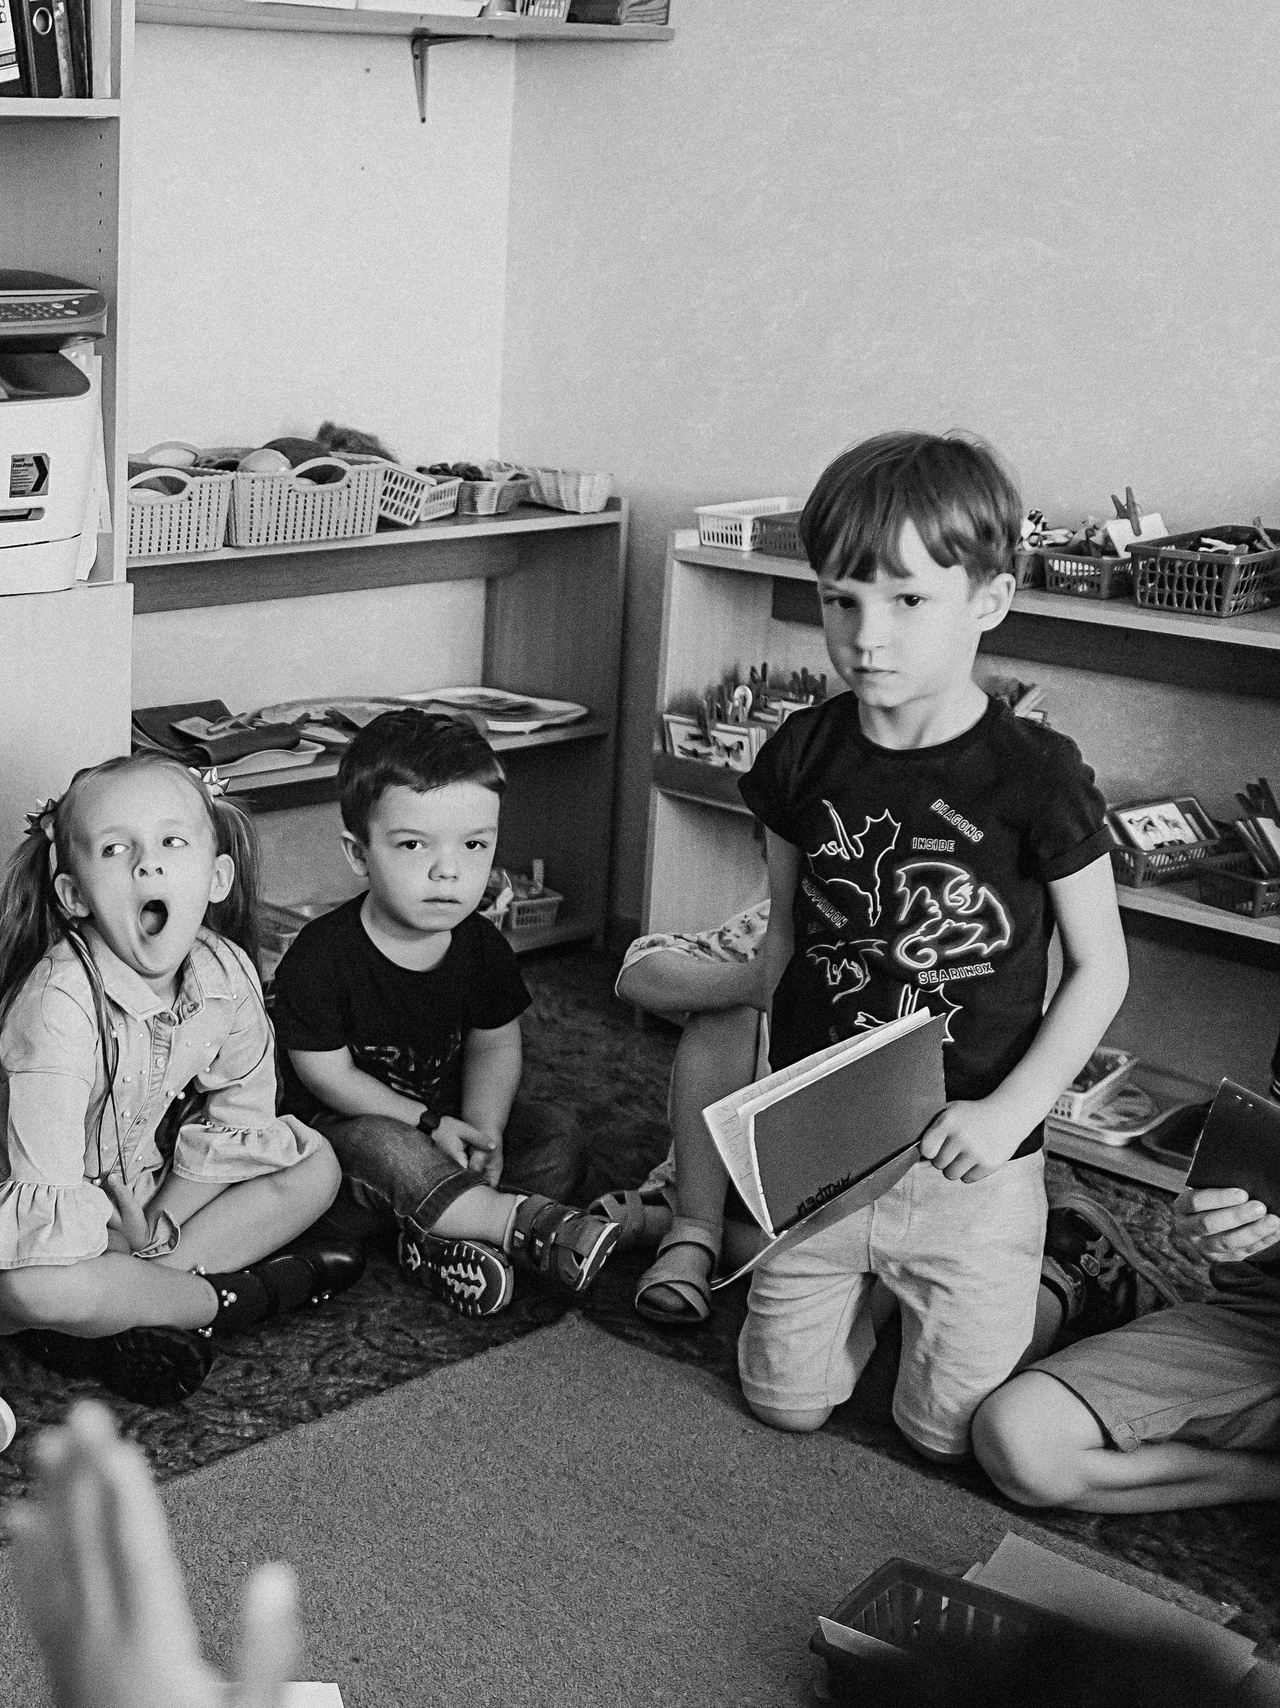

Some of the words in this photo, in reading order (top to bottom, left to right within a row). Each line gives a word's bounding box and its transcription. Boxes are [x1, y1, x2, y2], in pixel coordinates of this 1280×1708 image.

[930, 799, 984, 843] DRAGONS
[912, 837, 955, 852] INSIDE
[919, 962, 995, 985] SEARINOX
